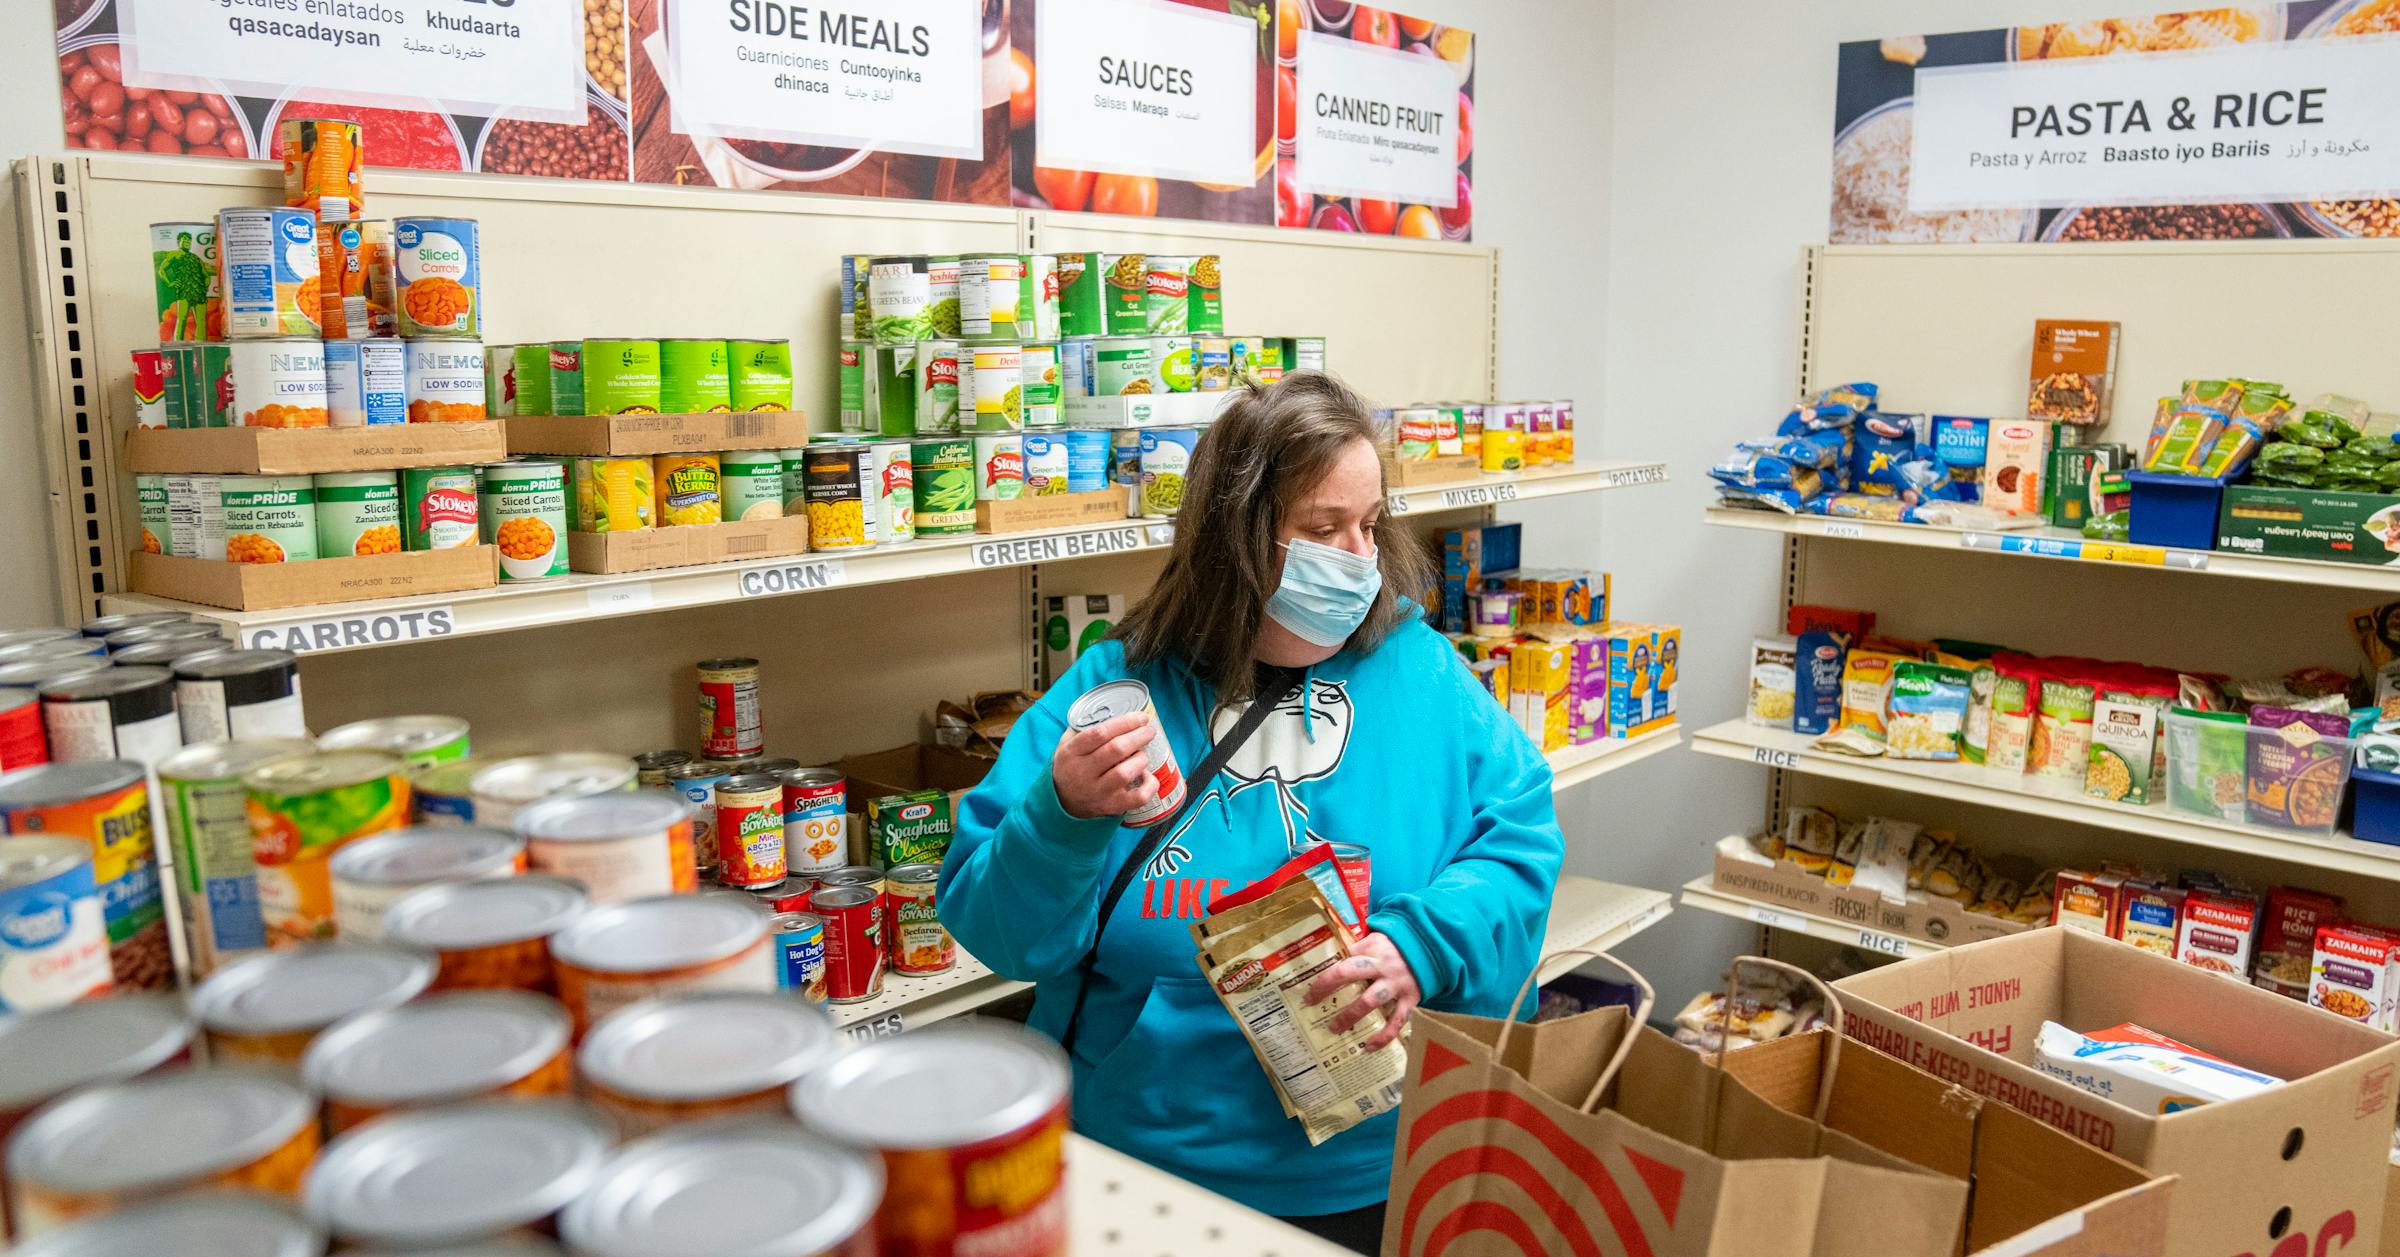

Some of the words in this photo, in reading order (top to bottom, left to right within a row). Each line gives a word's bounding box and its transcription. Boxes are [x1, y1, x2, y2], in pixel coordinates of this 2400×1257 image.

[305, 0, 405, 25] enlatados
[228, 15, 381, 48] qasacadaysan
[426, 9, 521, 39] khudaarta
[729, 0, 809, 41] SIDE
[819, 10, 931, 58] MEALS
[736, 45, 830, 72] Guarniciones
[840, 59, 922, 84] Cuntooyinka
[774, 73, 830, 95] dhinaca
[1098, 56, 1194, 97] SAUCES
[1093, 94, 1128, 112] Salsas
[1131, 98, 1169, 118] Maraqa
[1314, 92, 1391, 127] CANNED
[1394, 106, 1444, 136] FRUIT
[2010, 100, 2152, 139] PASTA
[2166, 97, 2197, 133] &
[2213, 87, 2328, 129] RICE
[1969, 151, 2019, 168] Pasta
[2022, 153, 2035, 170] y
[2038, 147, 2088, 166] Arroz
[2103, 145, 2171, 163] Baasto
[2175, 144, 2206, 162] iyo
[2211, 140, 2271, 159] Bariis
[418, 248, 460, 262] Sliced
[421, 263, 461, 275] Carrots
[280, 384, 305, 393] LOW
[426, 380, 450, 390] LOW
[1938, 433, 1986, 447] ROTINI
[529, 479, 561, 491] PRIDE
[673, 471, 716, 483] BUTTER
[675, 481, 717, 492] KERNEL
[1390, 496, 1408, 513] AS
[1445, 488, 1488, 507] MIXED
[1490, 484, 1516, 502] VEG
[1613, 467, 1665, 486] POTATOES
[252, 492, 297, 505] PRIDE
[501, 497, 531, 506] Sliced
[227, 510, 253, 521] Sliced
[256, 510, 297, 521] Carrots
[363, 503, 389, 514] Sliced
[1825, 526, 1861, 540] PASTA
[2264, 526, 2301, 538] Lasagna
[2301, 527, 2330, 540] Ready
[2330, 531, 2355, 542] Oven
[979, 537, 1059, 567] GREEN
[1066, 529, 1139, 556] BEANS
[2104, 549, 2113, 560] 3
[742, 563, 829, 597] CORN
[250, 609, 454, 651] CARROTS
[2098, 723, 2148, 740] QUINOA
[1755, 748, 1799, 768] RICE
[904, 807, 928, 819] Kraft
[758, 833, 777, 843] Mini
[885, 818, 951, 847] Spaghetti
[890, 838, 945, 863] Classics
[897, 907, 938, 923] BOYARD
[1757, 912, 1780, 924] RICE
[1834, 897, 1867, 922] FRESH
[2284, 906, 2316, 921] RICE
[903, 926, 943, 937] Beefaroni
[1860, 932, 1906, 954] RICE
[789, 950, 801, 960] Hot
[806, 945, 819, 957] Dog
[802, 960, 819, 973] Salsa
[1222, 960, 1264, 993] IDAHOAN
[1968, 977, 2021, 1009] HANDLE
[1930, 990, 1960, 1019] WITH
[2047, 1065, 2073, 1082] hang
[2098, 1079, 2113, 1093] at
